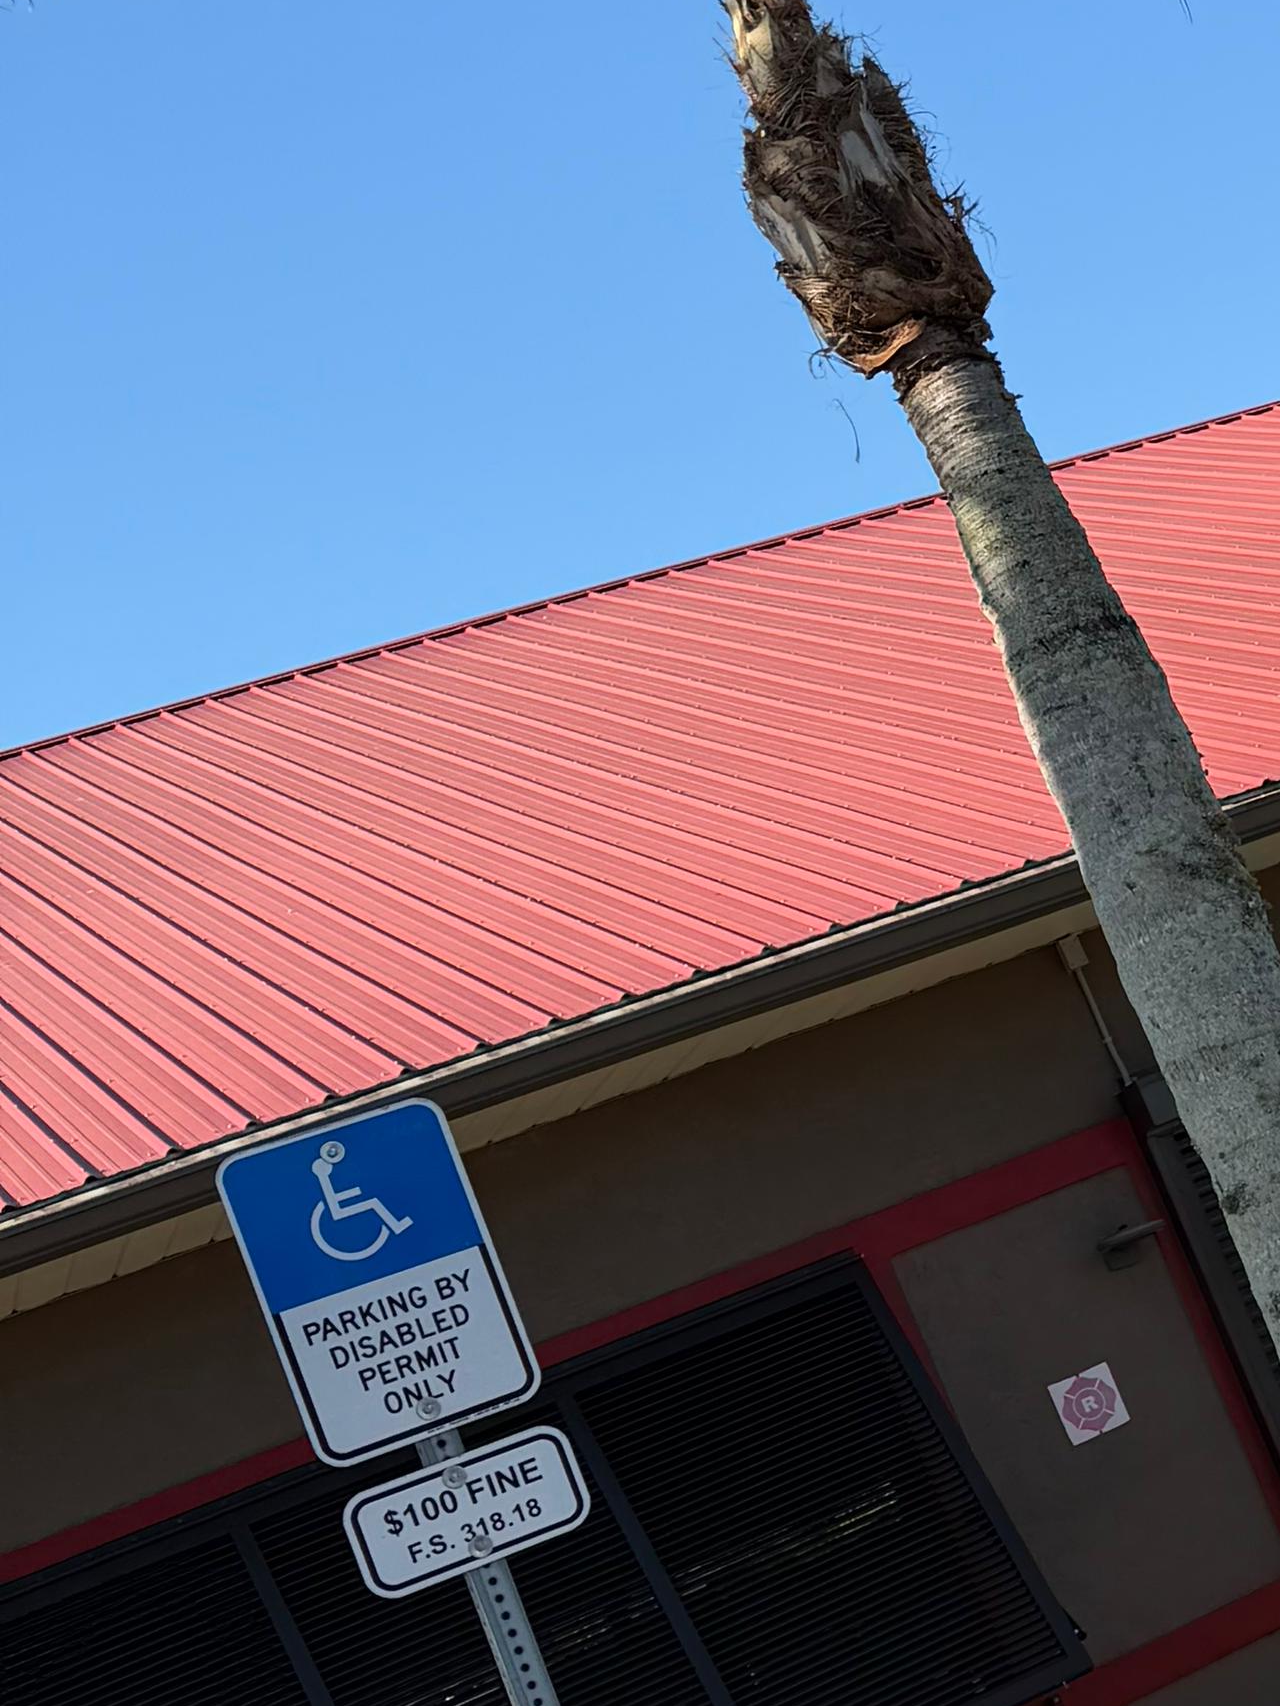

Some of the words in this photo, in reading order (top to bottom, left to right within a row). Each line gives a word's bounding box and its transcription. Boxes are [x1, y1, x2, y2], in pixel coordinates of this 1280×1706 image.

[301, 1286, 428, 1347] PARKING
[433, 1267, 471, 1301] BY
[328, 1303, 470, 1370] DISABLED
[357, 1336, 460, 1392] PERMIT
[383, 1369, 456, 1414] ONLY
[1081, 1394, 1099, 1413] R
[383, 1490, 459, 1538] $100
[466, 1456, 544, 1505] FINE
[407, 1533, 456, 1564] F.S.
[460, 1498, 542, 1543] 318.18
